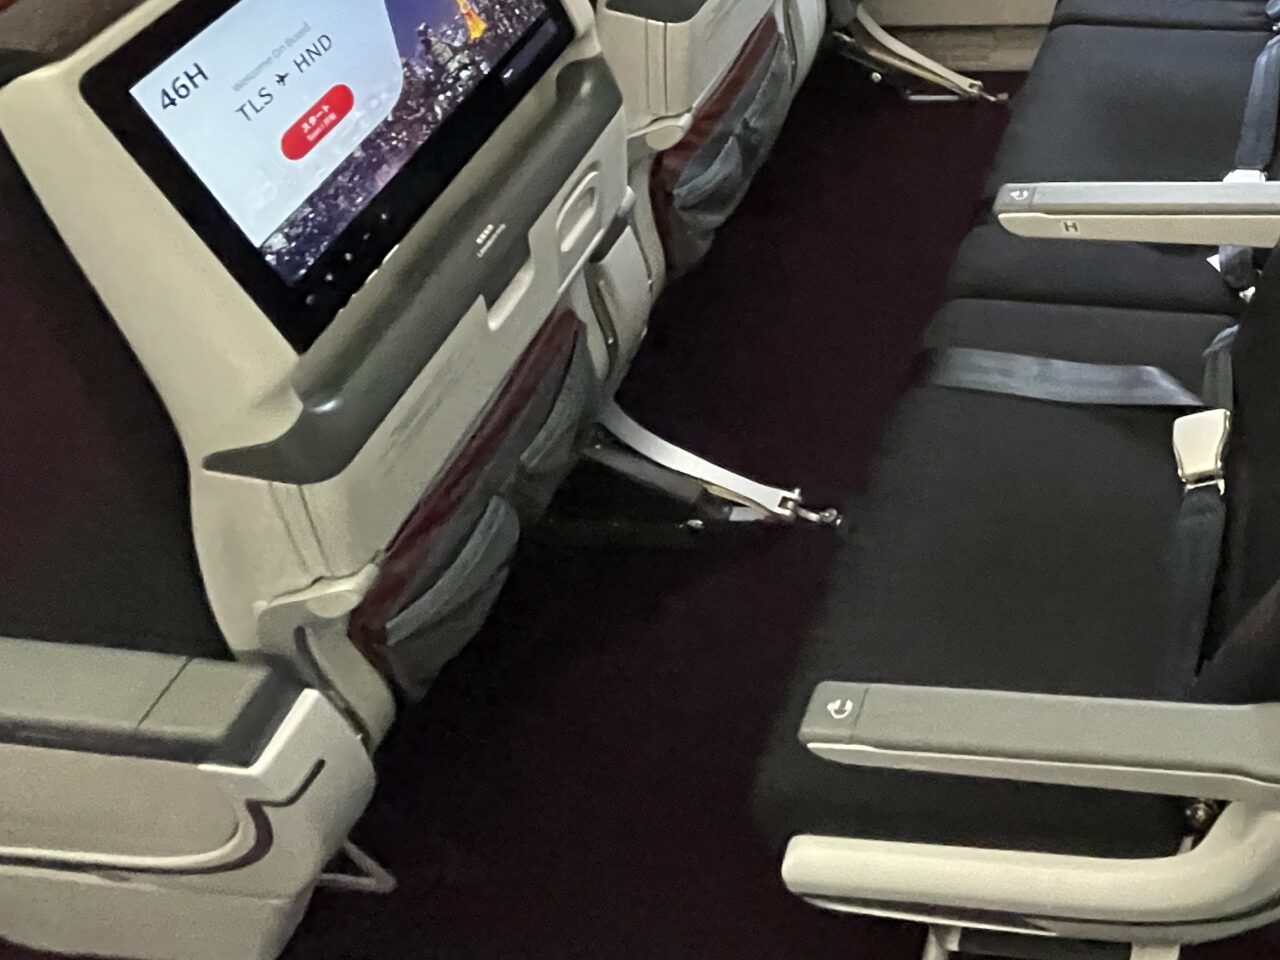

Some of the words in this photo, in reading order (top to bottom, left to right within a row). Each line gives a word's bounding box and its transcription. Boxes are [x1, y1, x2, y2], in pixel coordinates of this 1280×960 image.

[160, 62, 209, 110] 46H
[235, 87, 274, 121] TLS
[293, 34, 333, 73] HND
[1063, 221, 1079, 232] H
